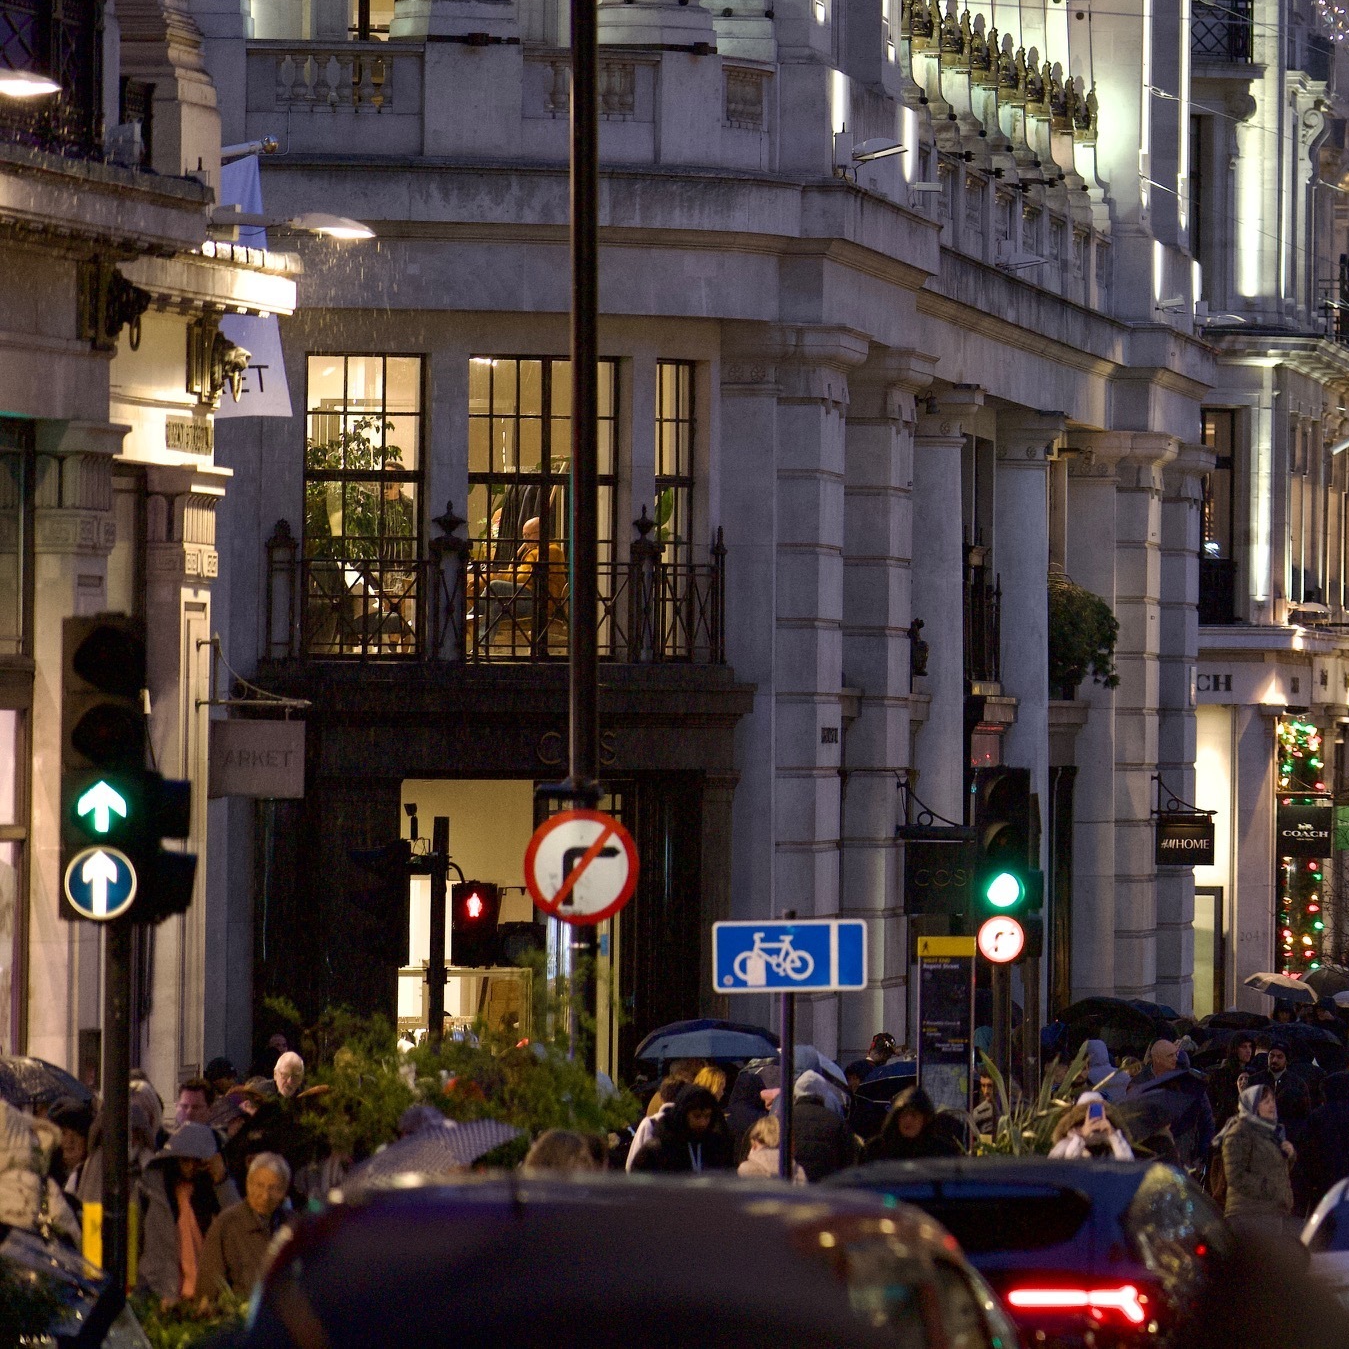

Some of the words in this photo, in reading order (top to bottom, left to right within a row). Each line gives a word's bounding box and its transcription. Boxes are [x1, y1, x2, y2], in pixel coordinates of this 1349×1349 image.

[537, 730, 617, 766] CS
[1282, 830, 1329, 838] COACH
[1176, 839, 1210, 849] HOME
[914, 869, 967, 887] COS
